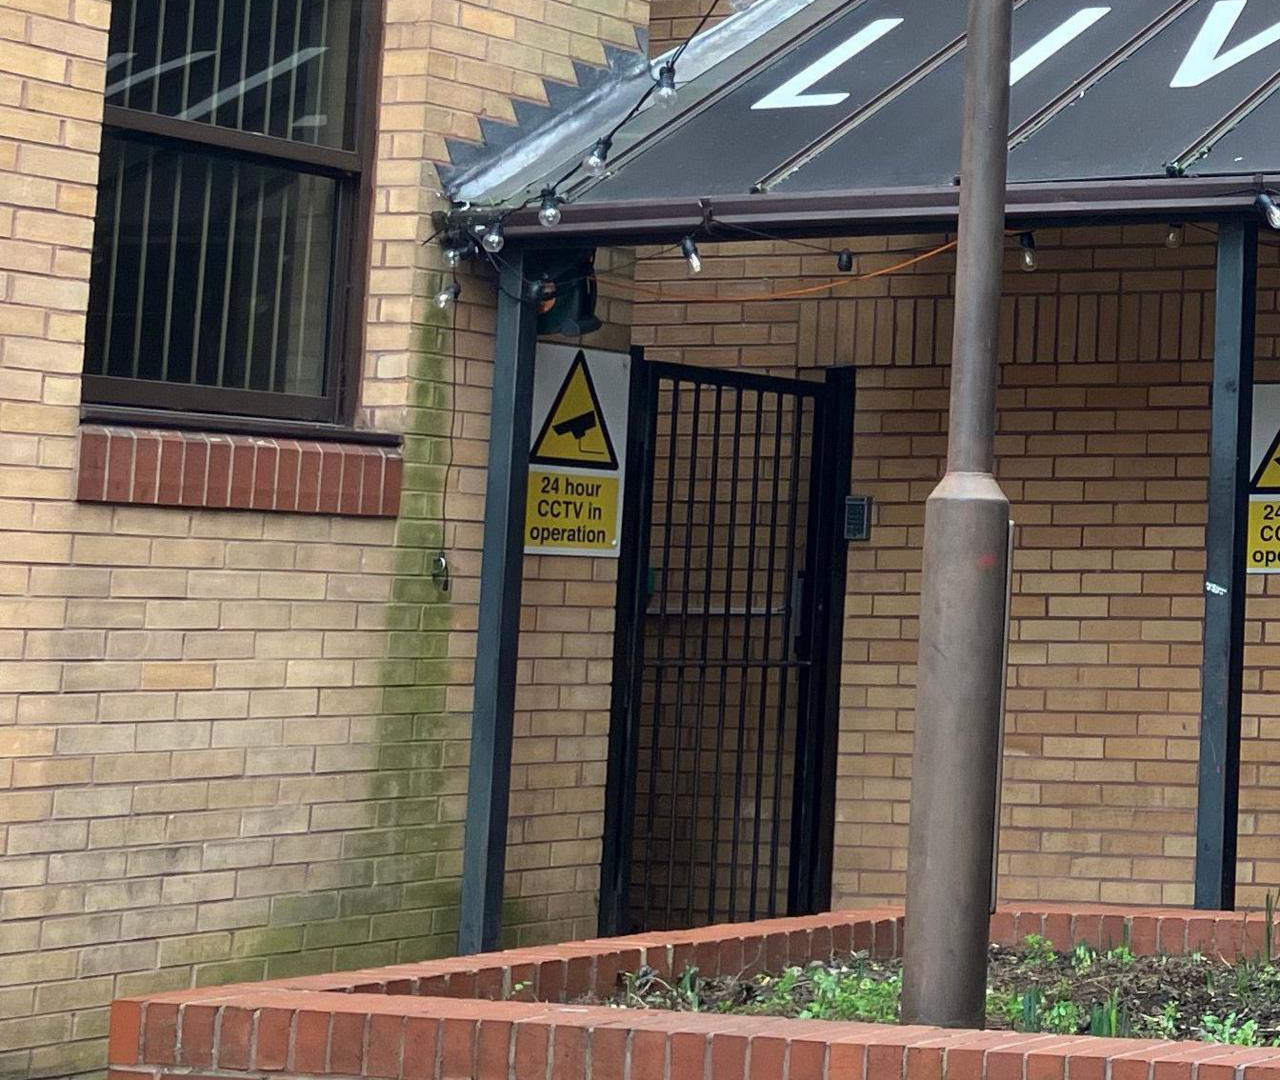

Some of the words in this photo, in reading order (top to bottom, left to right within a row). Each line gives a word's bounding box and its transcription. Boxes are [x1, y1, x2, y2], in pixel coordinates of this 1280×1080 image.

[541, 476, 559, 494] 24
[565, 477, 602, 497] hour
[537, 499, 584, 519] CCTV
[588, 502, 602, 520] in
[530, 524, 606, 545] operation
